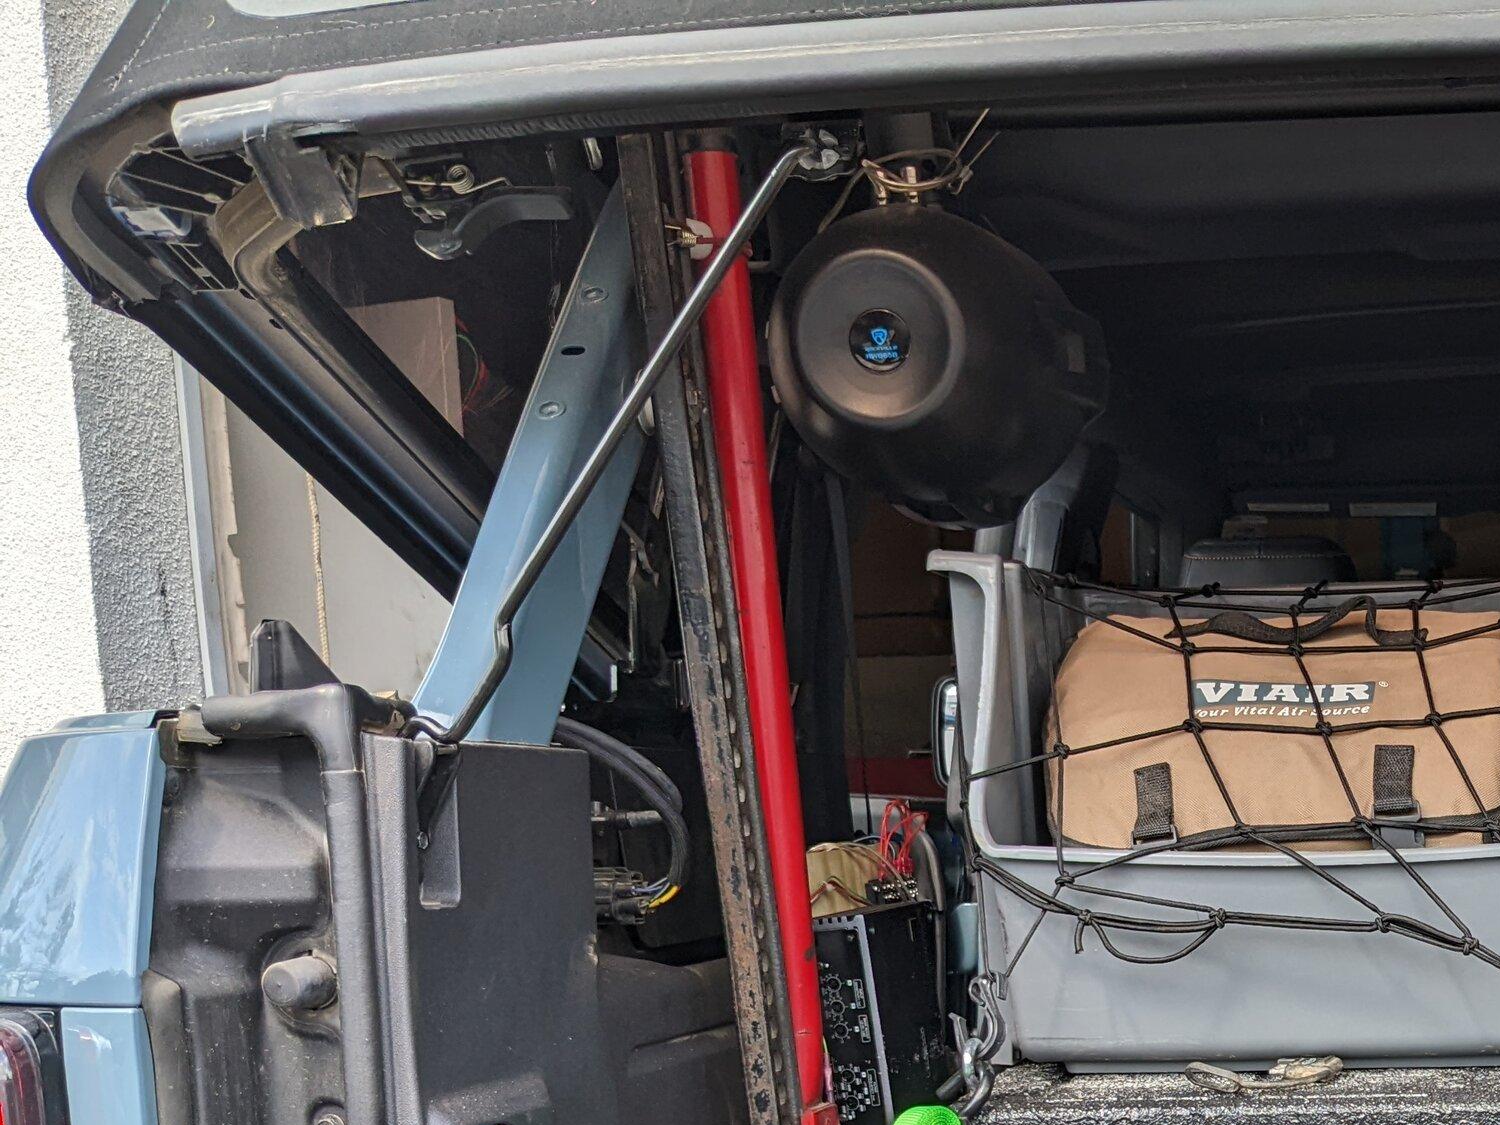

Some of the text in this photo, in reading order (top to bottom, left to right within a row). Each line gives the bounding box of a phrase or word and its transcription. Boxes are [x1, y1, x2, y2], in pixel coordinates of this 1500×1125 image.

[1196, 681, 1370, 703] VIAIR
[1234, 706, 1275, 716] Vital
[1278, 706, 1308, 717] Air
